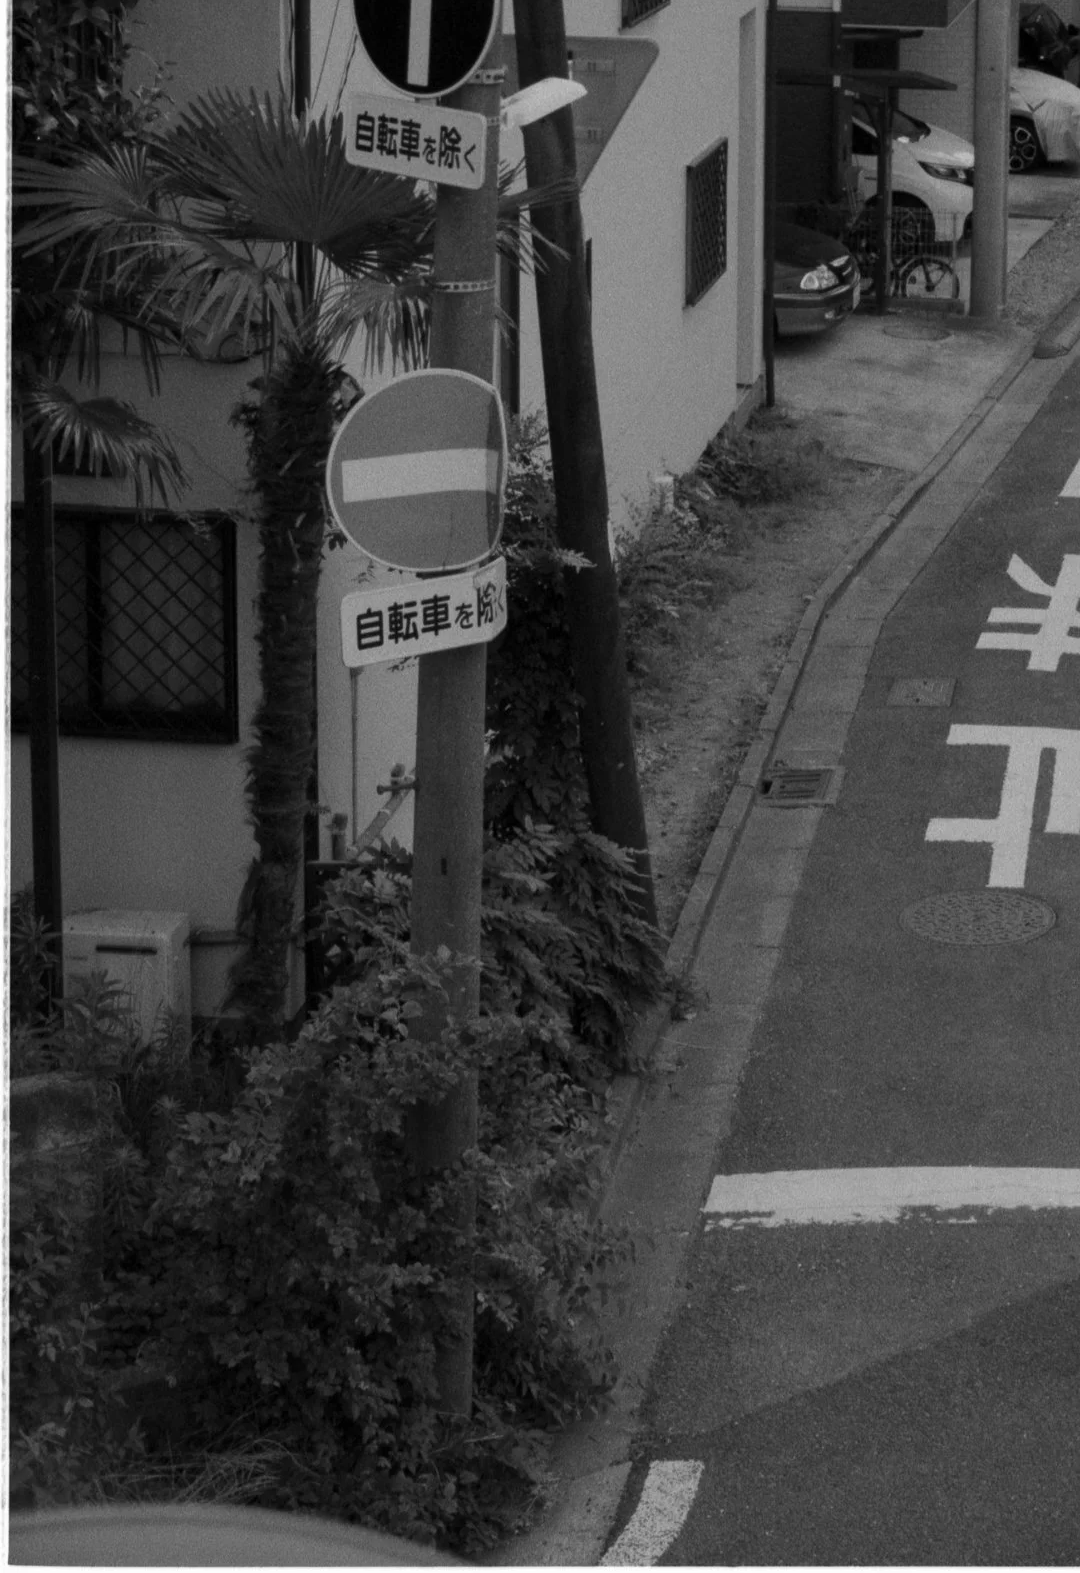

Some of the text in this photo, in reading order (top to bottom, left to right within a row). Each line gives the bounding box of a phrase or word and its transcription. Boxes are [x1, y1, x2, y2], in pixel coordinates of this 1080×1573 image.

[354, 109, 478, 174] 自転車を除く
[355, 580, 505, 652] 自転車を除く
